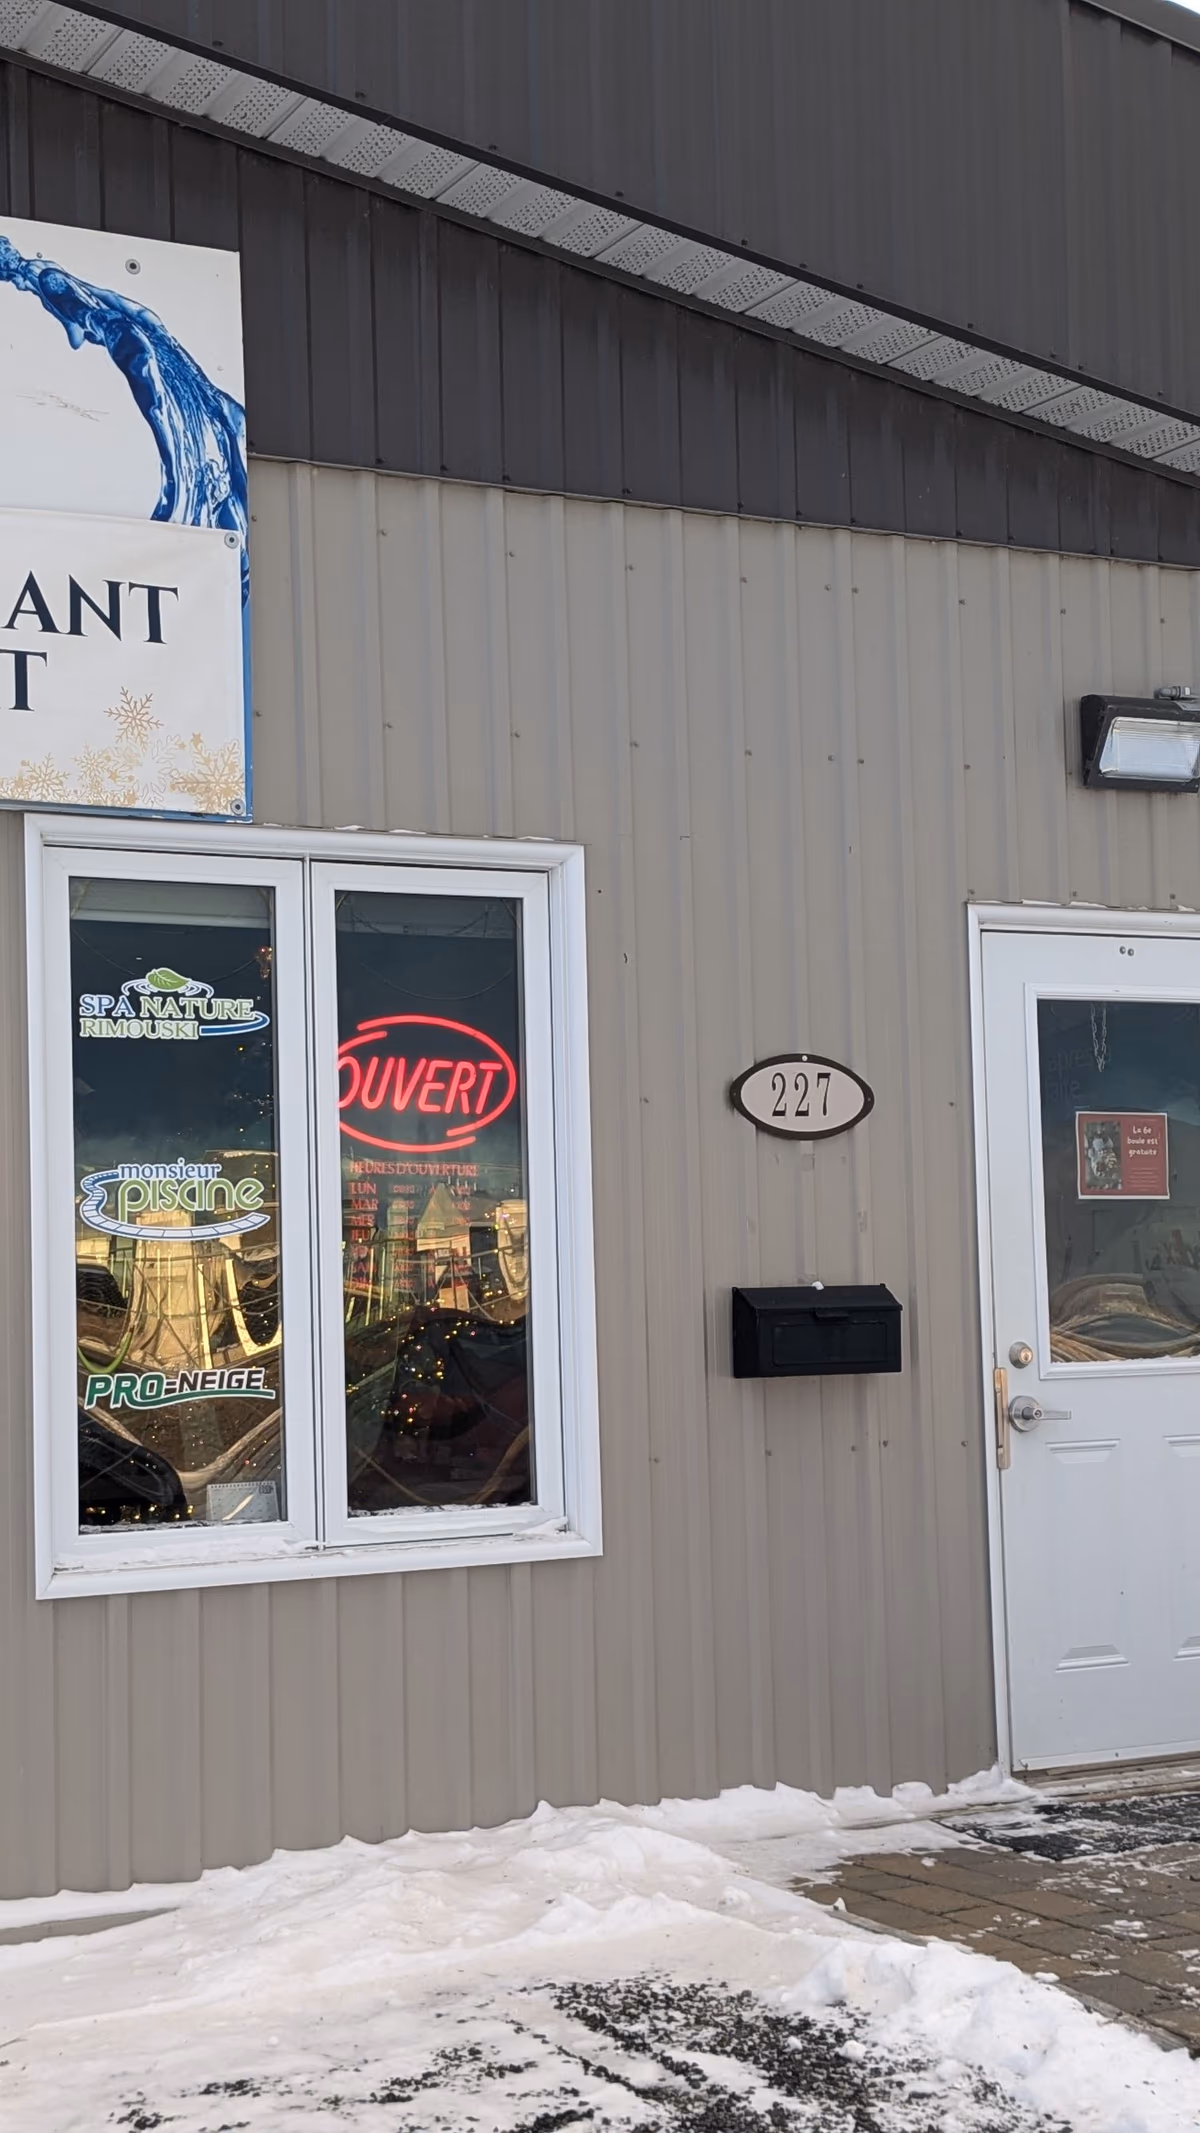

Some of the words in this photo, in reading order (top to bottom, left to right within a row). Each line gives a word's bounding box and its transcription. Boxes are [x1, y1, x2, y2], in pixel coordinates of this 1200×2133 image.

[1, 570, 179, 645] ANT
[79, 994, 136, 1017] SPA
[139, 996, 256, 1020] NATURE
[79, 1018, 199, 1039] RIMOUSKI
[338, 1056, 503, 1115] OUVERT
[771, 1072, 831, 1117] 227
[1127, 1136, 1145, 1145] boule
[1147, 1137, 1159, 1146] est
[1128, 1148, 1157, 1158] gratuite
[119, 1158, 222, 1179] monsieur
[349, 1182, 377, 1195] LUN
[118, 1178, 265, 1223] piscine
[351, 1200, 378, 1211] MAR
